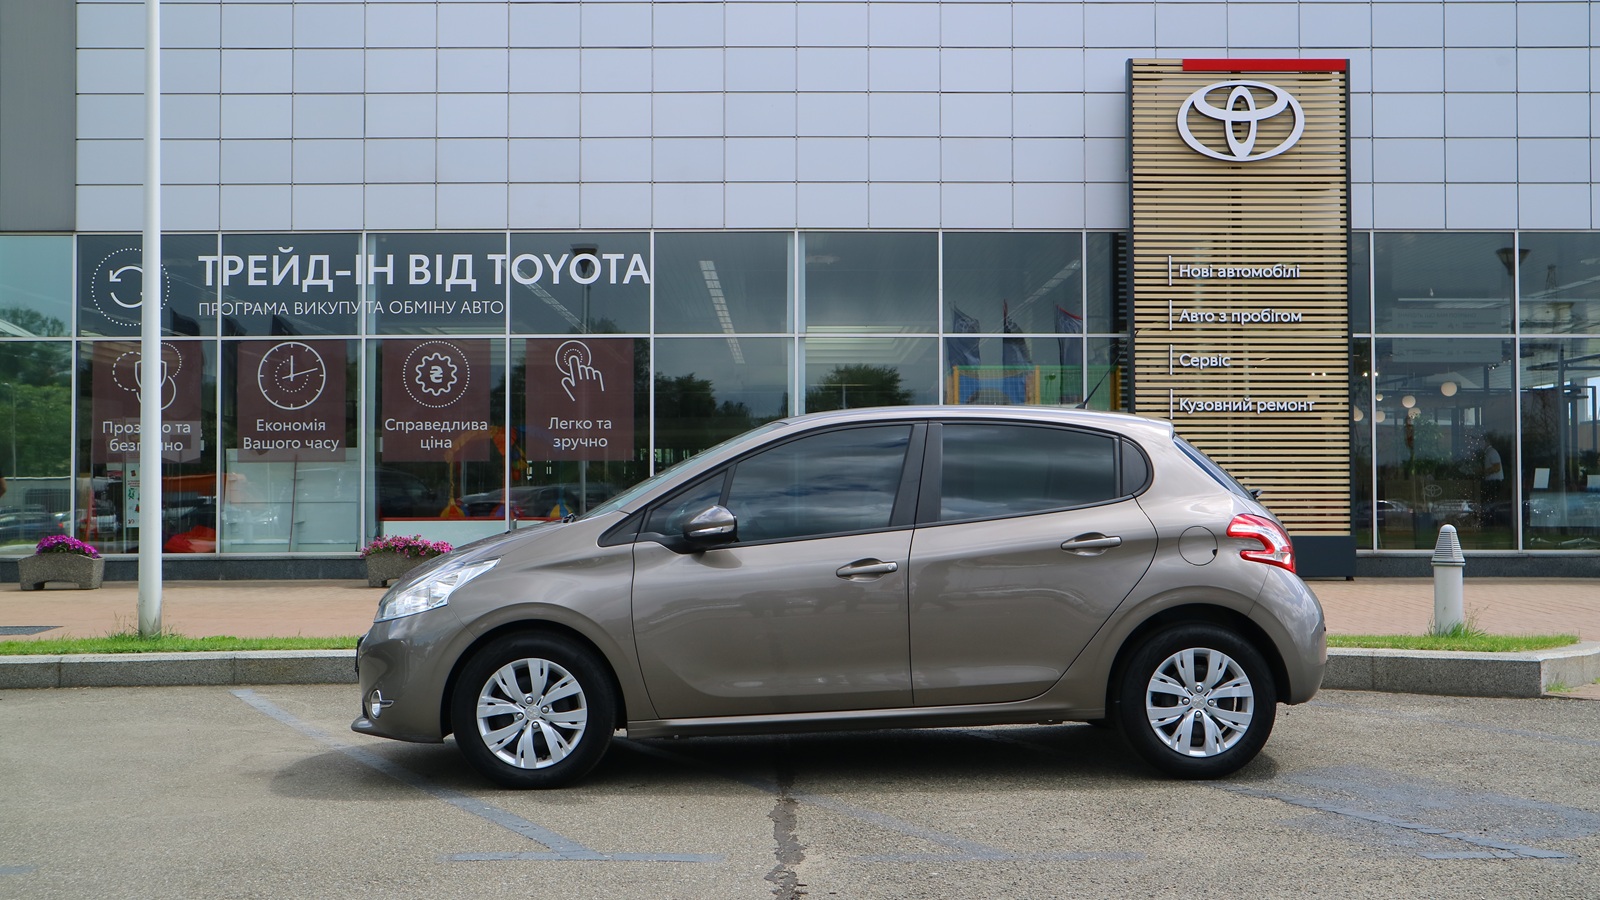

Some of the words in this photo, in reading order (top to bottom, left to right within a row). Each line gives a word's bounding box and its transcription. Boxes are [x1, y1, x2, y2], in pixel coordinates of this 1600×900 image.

[198, 246, 394, 293] ТРЕЙД-ІН
[408, 253, 477, 293] ВІД
[487, 253, 651, 285] TOYOTA
[1178, 264, 1213, 279] Нові
[1217, 264, 1301, 279] автомобілі
[198, 301, 288, 316] ПРОГРАМА
[295, 301, 362, 316] ВИКУПУ
[365, 301, 385, 315] ТА
[389, 300, 457, 315] ОБМІНУ
[460, 300, 504, 315] АВТО
[1178, 309, 1215, 323] Авто
[1218, 312, 1227, 323] з
[1231, 308, 1303, 326] пробігом
[1178, 353, 1232, 370] Сервіс
[1178, 397, 1253, 414] Кузовний
[1257, 399, 1315, 414] ремонт
[102, 421, 172, 437] Прозо
[175, 423, 191, 434] та
[256, 418, 326, 432] Економія
[384, 418, 488, 433] Справедлива
[548, 417, 593, 430] Легко
[596, 419, 612, 430] та
[243, 437, 303, 450] Вашого
[305, 439, 340, 452] часу
[420, 436, 452, 450] ціна
[552, 436, 608, 450] зручно
